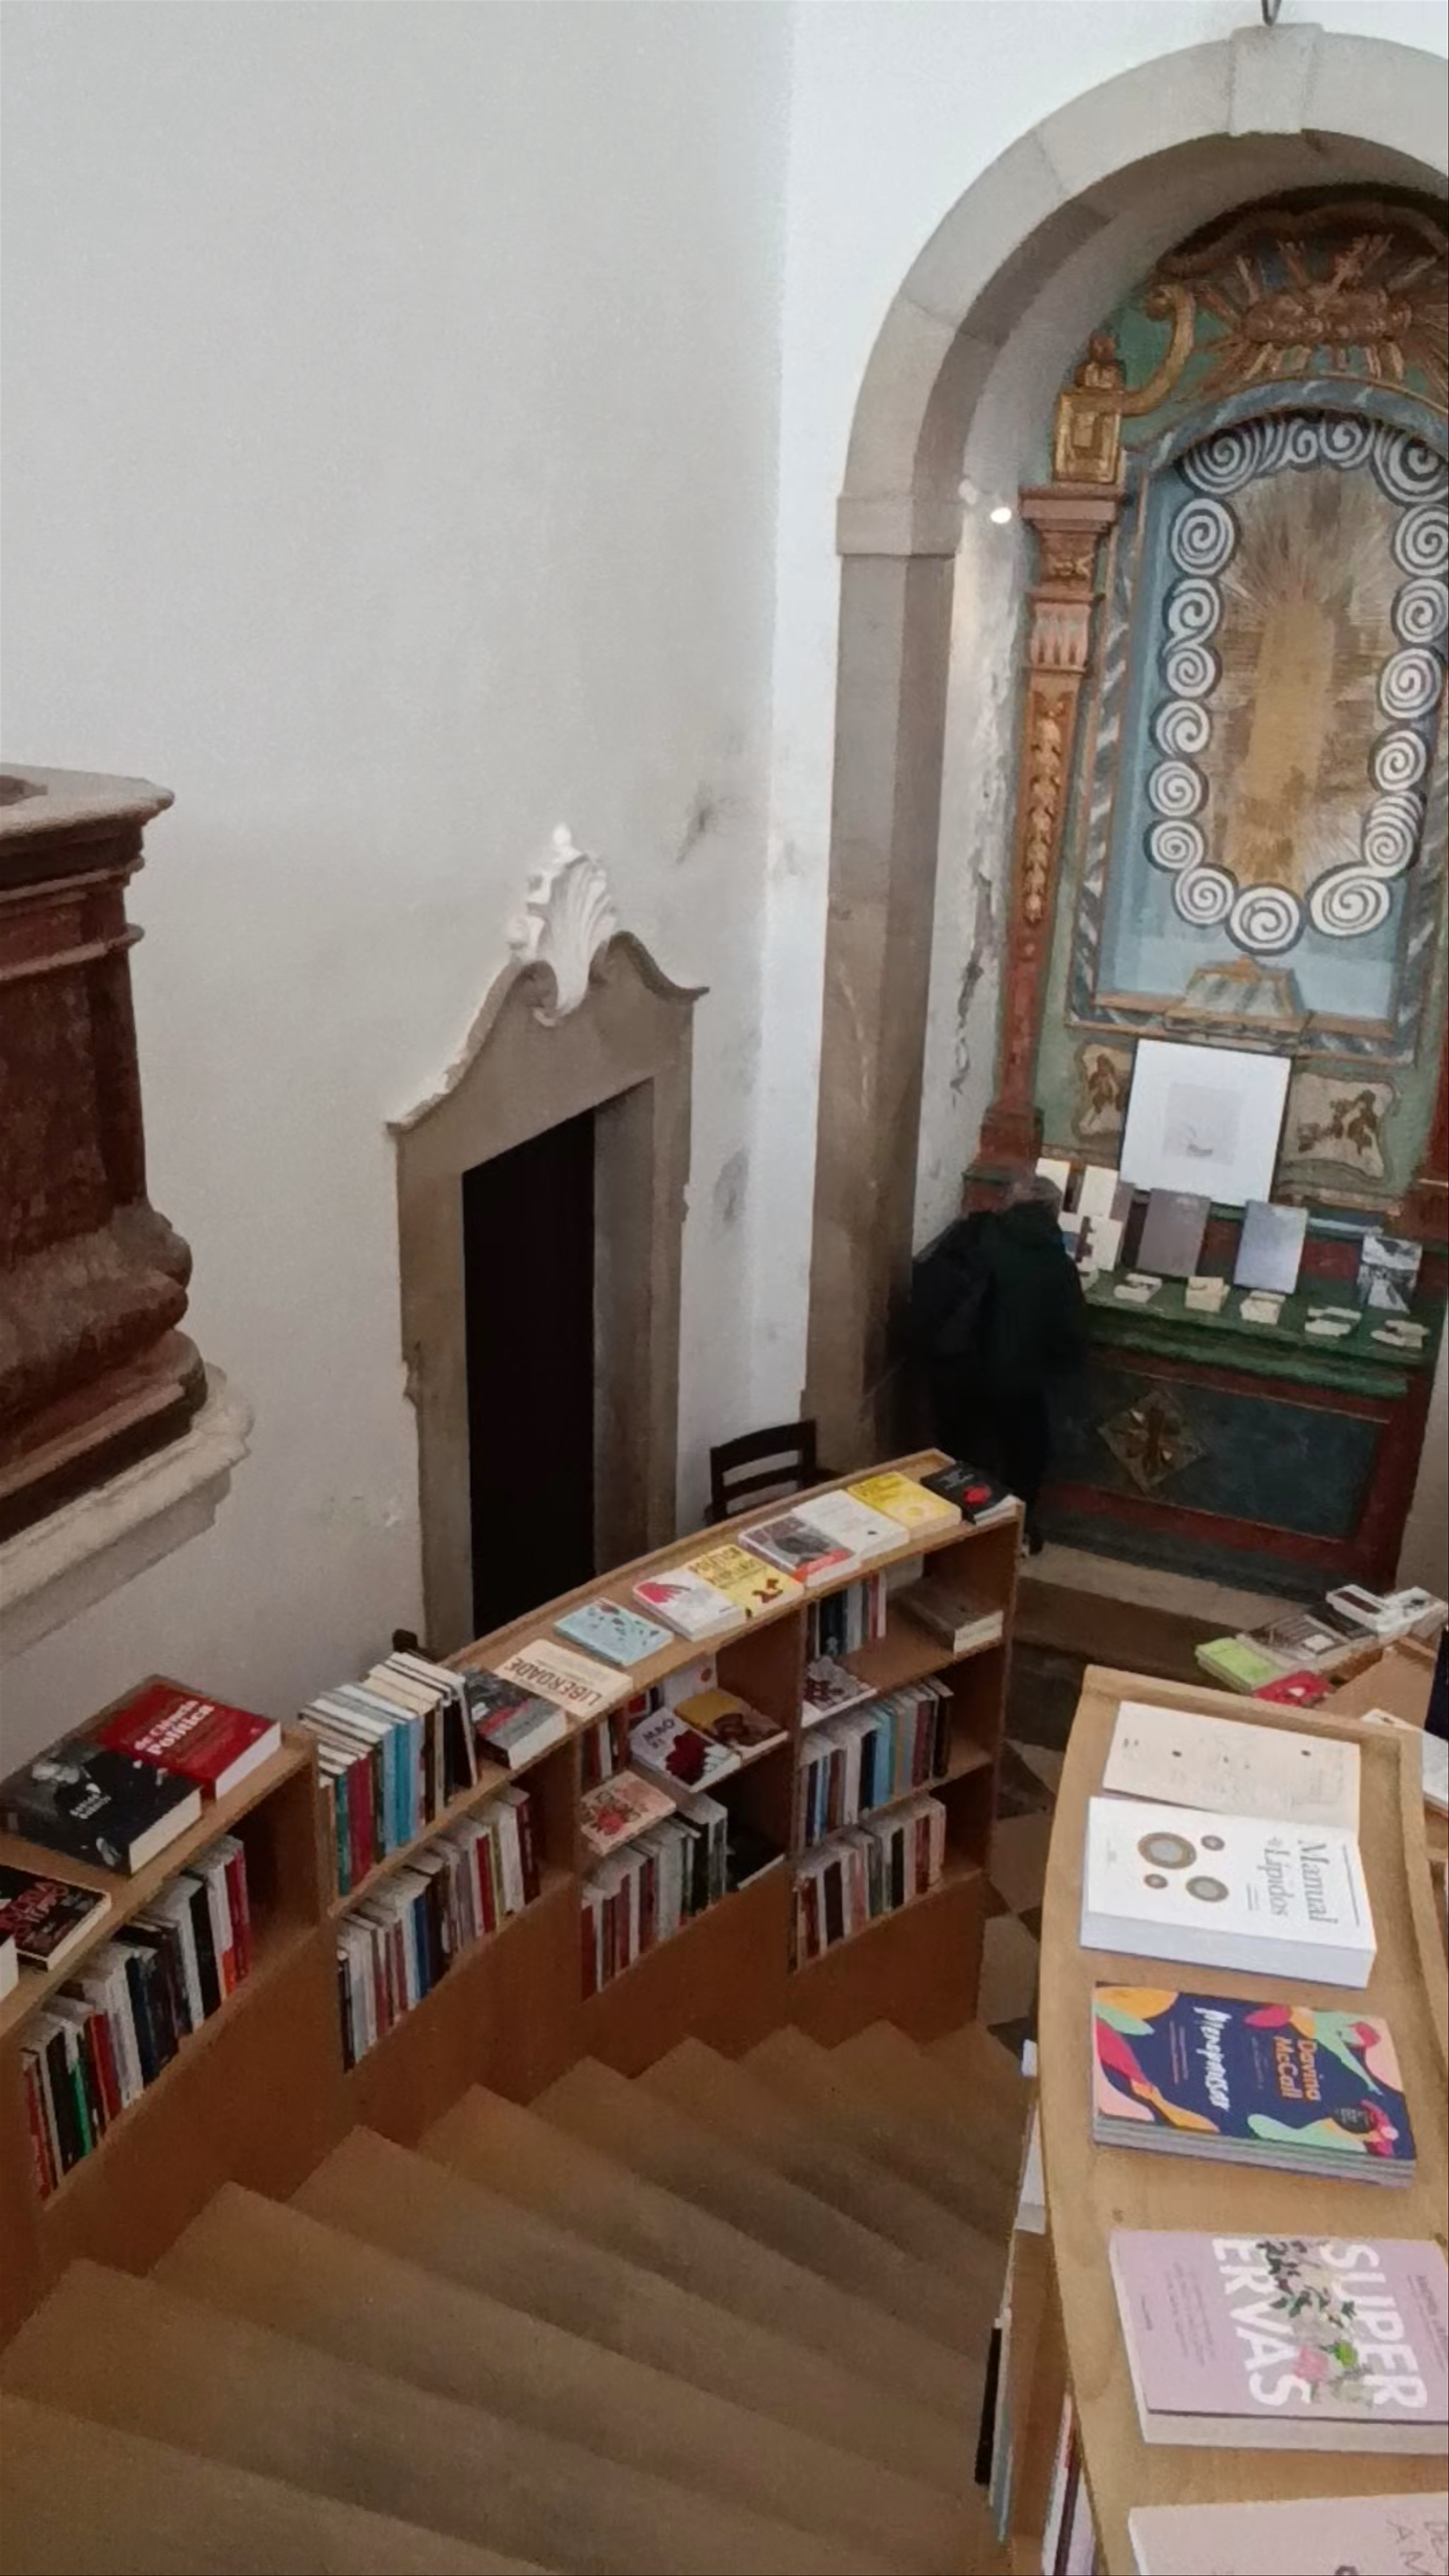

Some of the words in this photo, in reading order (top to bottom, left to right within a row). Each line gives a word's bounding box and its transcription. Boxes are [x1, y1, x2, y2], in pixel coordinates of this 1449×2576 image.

[505, 1658, 604, 1706] LIBERDADE
[1298, 1839, 1338, 1924] Manual
[1275, 2035, 1302, 2100] McCall
[1297, 2038, 1324, 2102] Davina
[1212, 2238, 1312, 2407] ERVAS
[1320, 2244, 1427, 2408] SUPER
